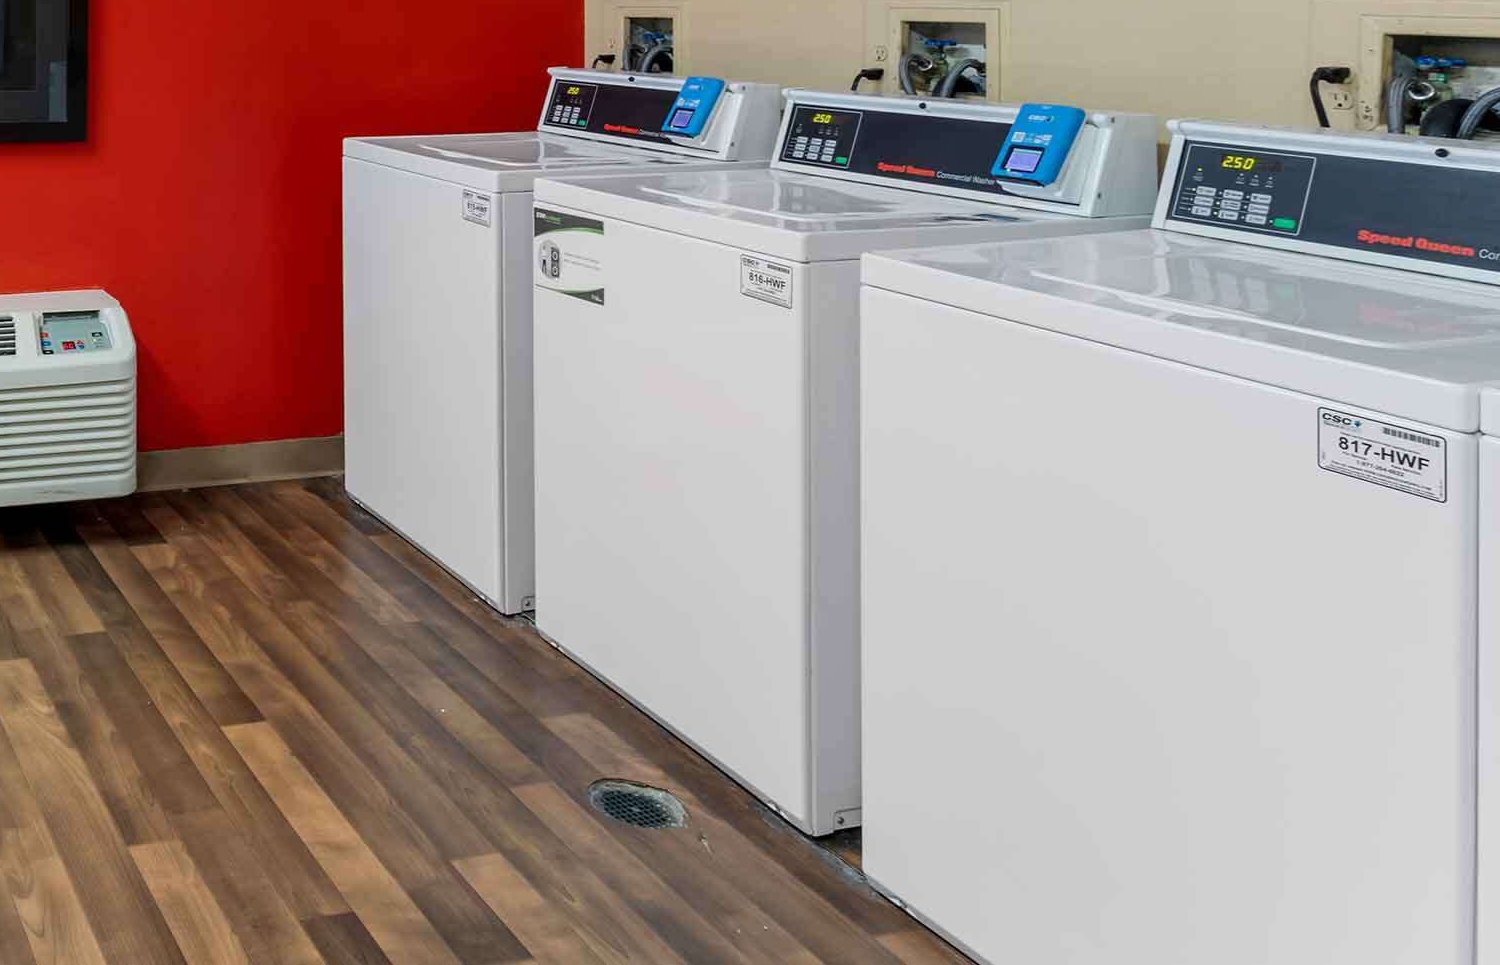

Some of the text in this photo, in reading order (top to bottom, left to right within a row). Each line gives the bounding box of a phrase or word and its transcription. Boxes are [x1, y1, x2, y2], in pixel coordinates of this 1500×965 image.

[1357, 229, 1413, 247] Speed
[1415, 238, 1475, 256] Queen
[748, 272, 786, 290] 816-HWF
[1322, 412, 1352, 426] CSC
[1338, 436, 1430, 470] 817-HWF
